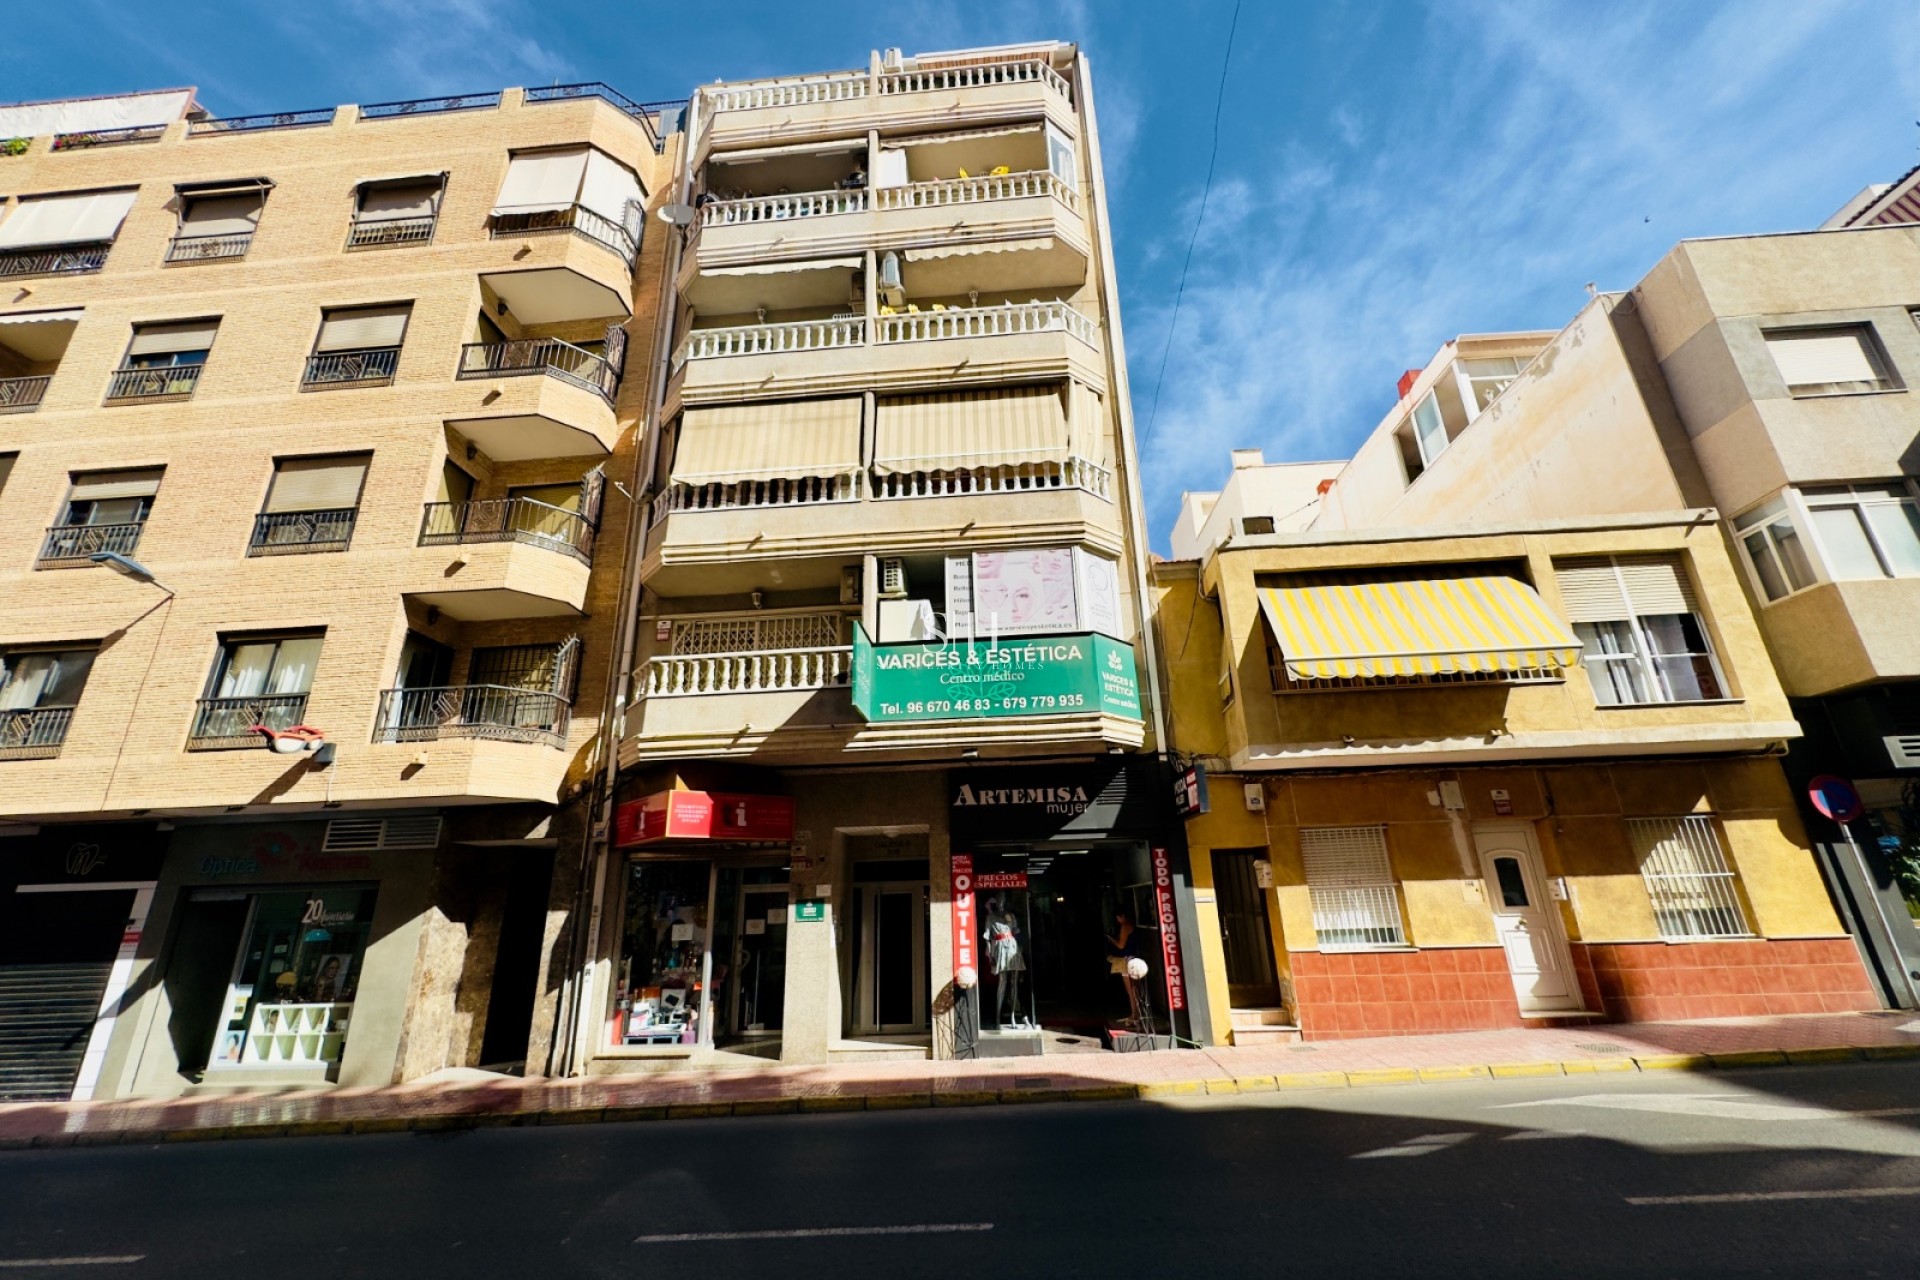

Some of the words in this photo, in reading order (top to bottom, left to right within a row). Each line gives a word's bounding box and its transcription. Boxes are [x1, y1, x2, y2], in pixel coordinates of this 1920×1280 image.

[877, 651, 960, 670] VARICES
[966, 651, 979, 665] &
[986, 643, 1083, 665] ESTÉTICA
[940, 673, 980, 684] Centro
[983, 671, 1025, 683] médico
[880, 703, 902, 714] Tel.
[907, 702, 923, 713] 96
[927, 701, 950, 712] 670
[954, 700, 970, 711] 46
[974, 699, 990, 710] 83
[1003, 697, 1026, 709] 679
[1031, 696, 1054, 707] 779
[1059, 694, 1083, 706] 935
[953, 784, 1088, 806] ARTEMISA
[1047, 802, 1089, 816] mujer
[978, 873, 1018, 881] PRECIOS
[1154, 848, 1170, 886] TODO
[974, 880, 1027, 888] ESPECIALES
[301, 899, 323, 924] 20
[954, 875, 972, 965] OUTLE
[1161, 892, 1182, 1009] PROMOCIONES
